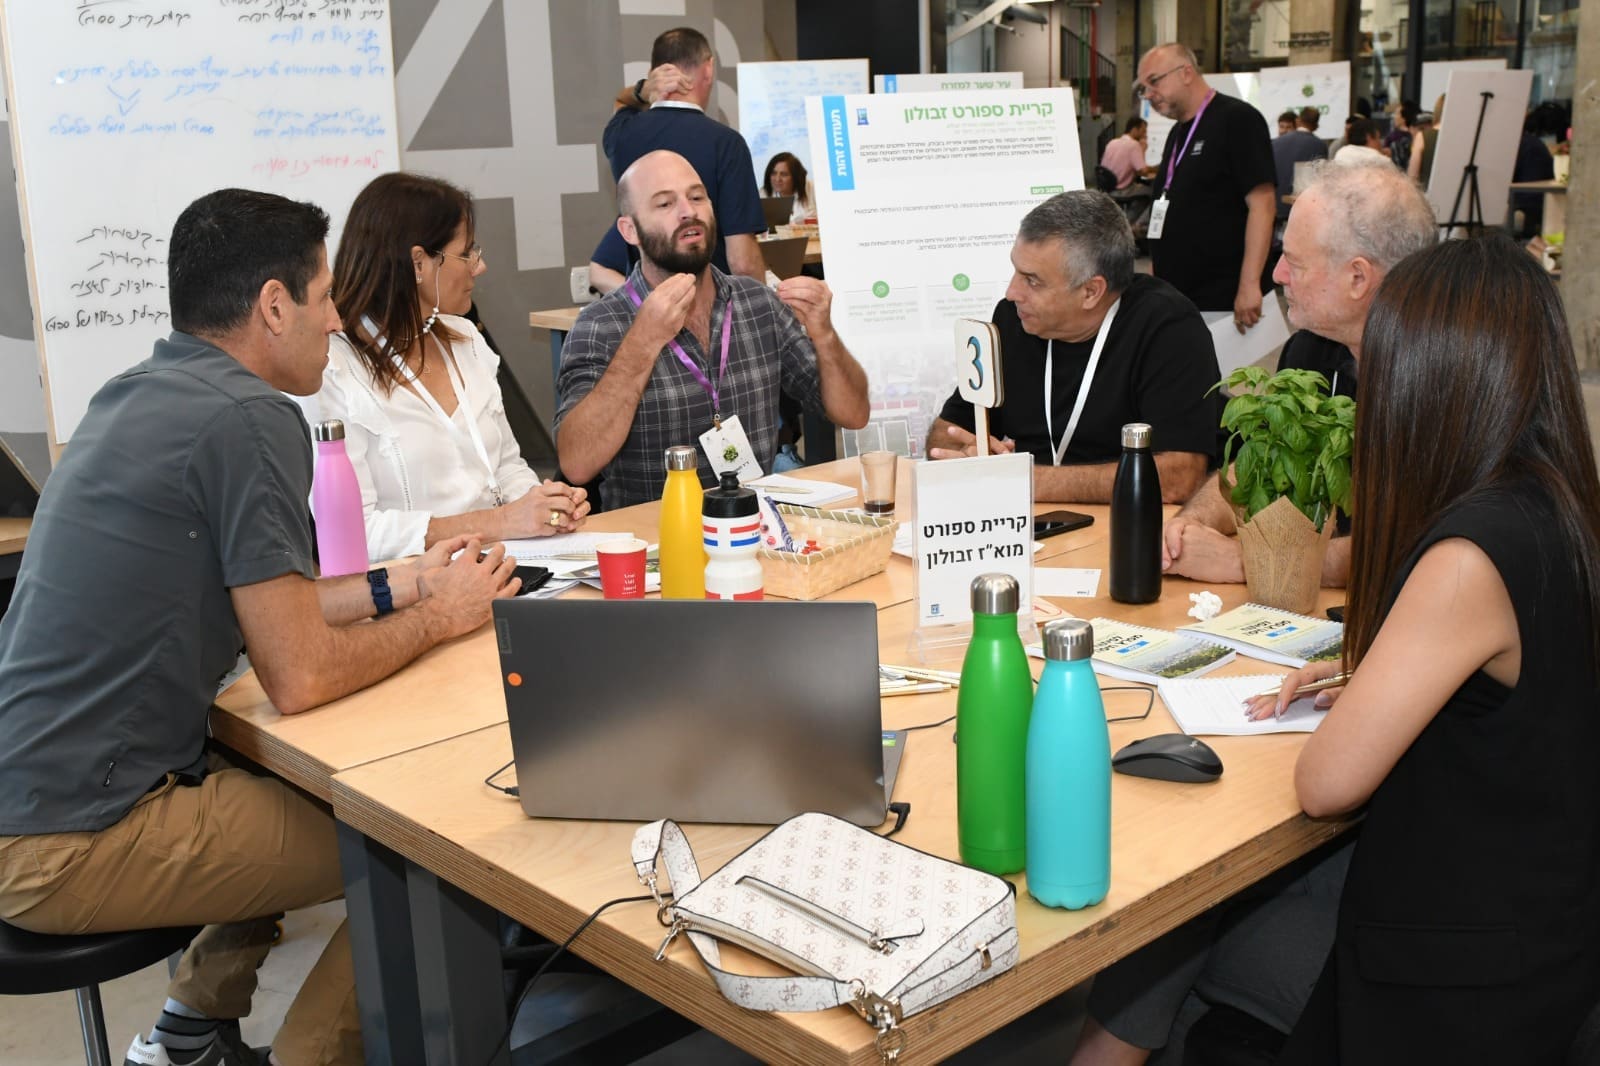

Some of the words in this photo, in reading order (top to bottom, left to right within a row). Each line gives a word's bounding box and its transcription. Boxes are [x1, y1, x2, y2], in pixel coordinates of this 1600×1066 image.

[904, 106, 948, 124] זבולון
[952, 104, 1005, 120] ספורט
[1008, 102, 1054, 118] קריית
[830, 108, 845, 147] תעודת
[835, 150, 848, 177] זהות
[966, 335, 984, 391] 3
[923, 520, 976, 539] ספורט
[980, 515, 1027, 533] קריית
[926, 548, 974, 570] זבולון
[978, 543, 1024, 561] מוא"ז
